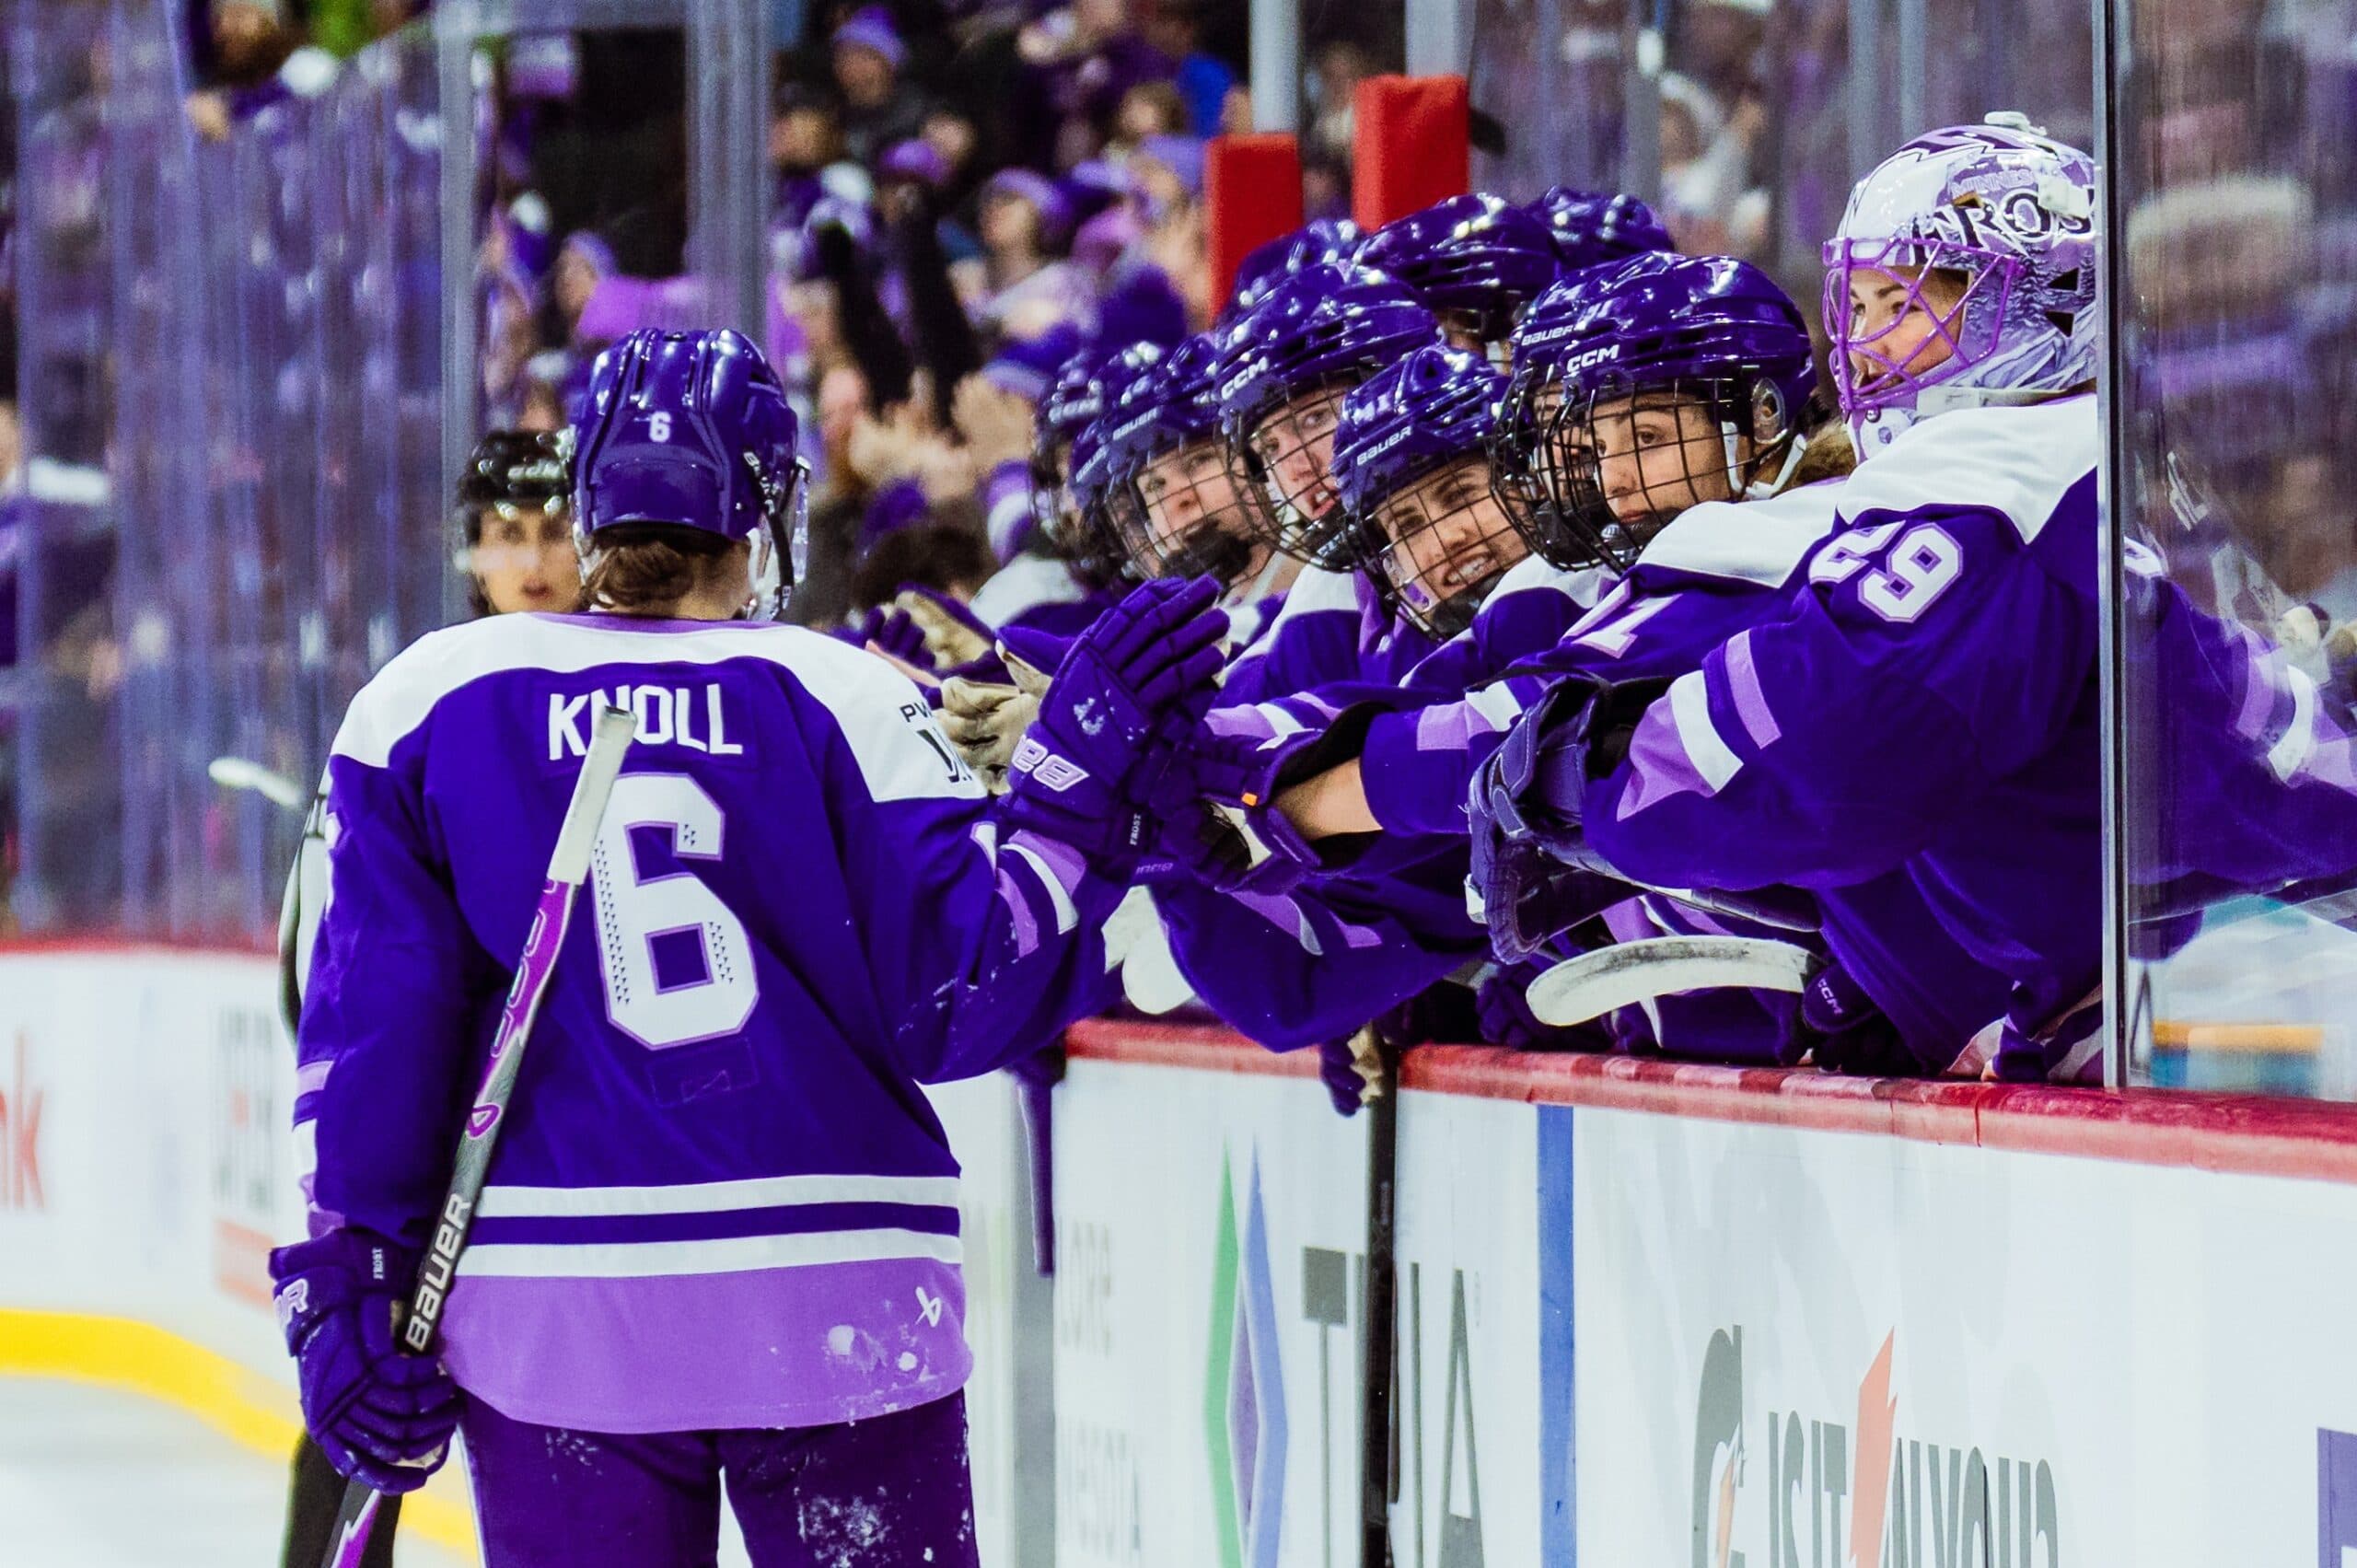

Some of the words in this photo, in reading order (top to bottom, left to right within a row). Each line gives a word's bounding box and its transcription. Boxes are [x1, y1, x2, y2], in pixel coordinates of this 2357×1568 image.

[1221, 355, 1269, 401] CCM
[1567, 344, 1620, 373] CCM
[648, 411, 671, 443] 6
[1357, 425, 1413, 467] BAUER
[1808, 519, 1964, 623] 29
[549, 683, 744, 761] KNOLL
[1129, 813, 1142, 846] FROST
[589, 772, 761, 1051] 6
[372, 1247, 385, 1281] FROST
[405, 1192, 472, 1353] BAUER
